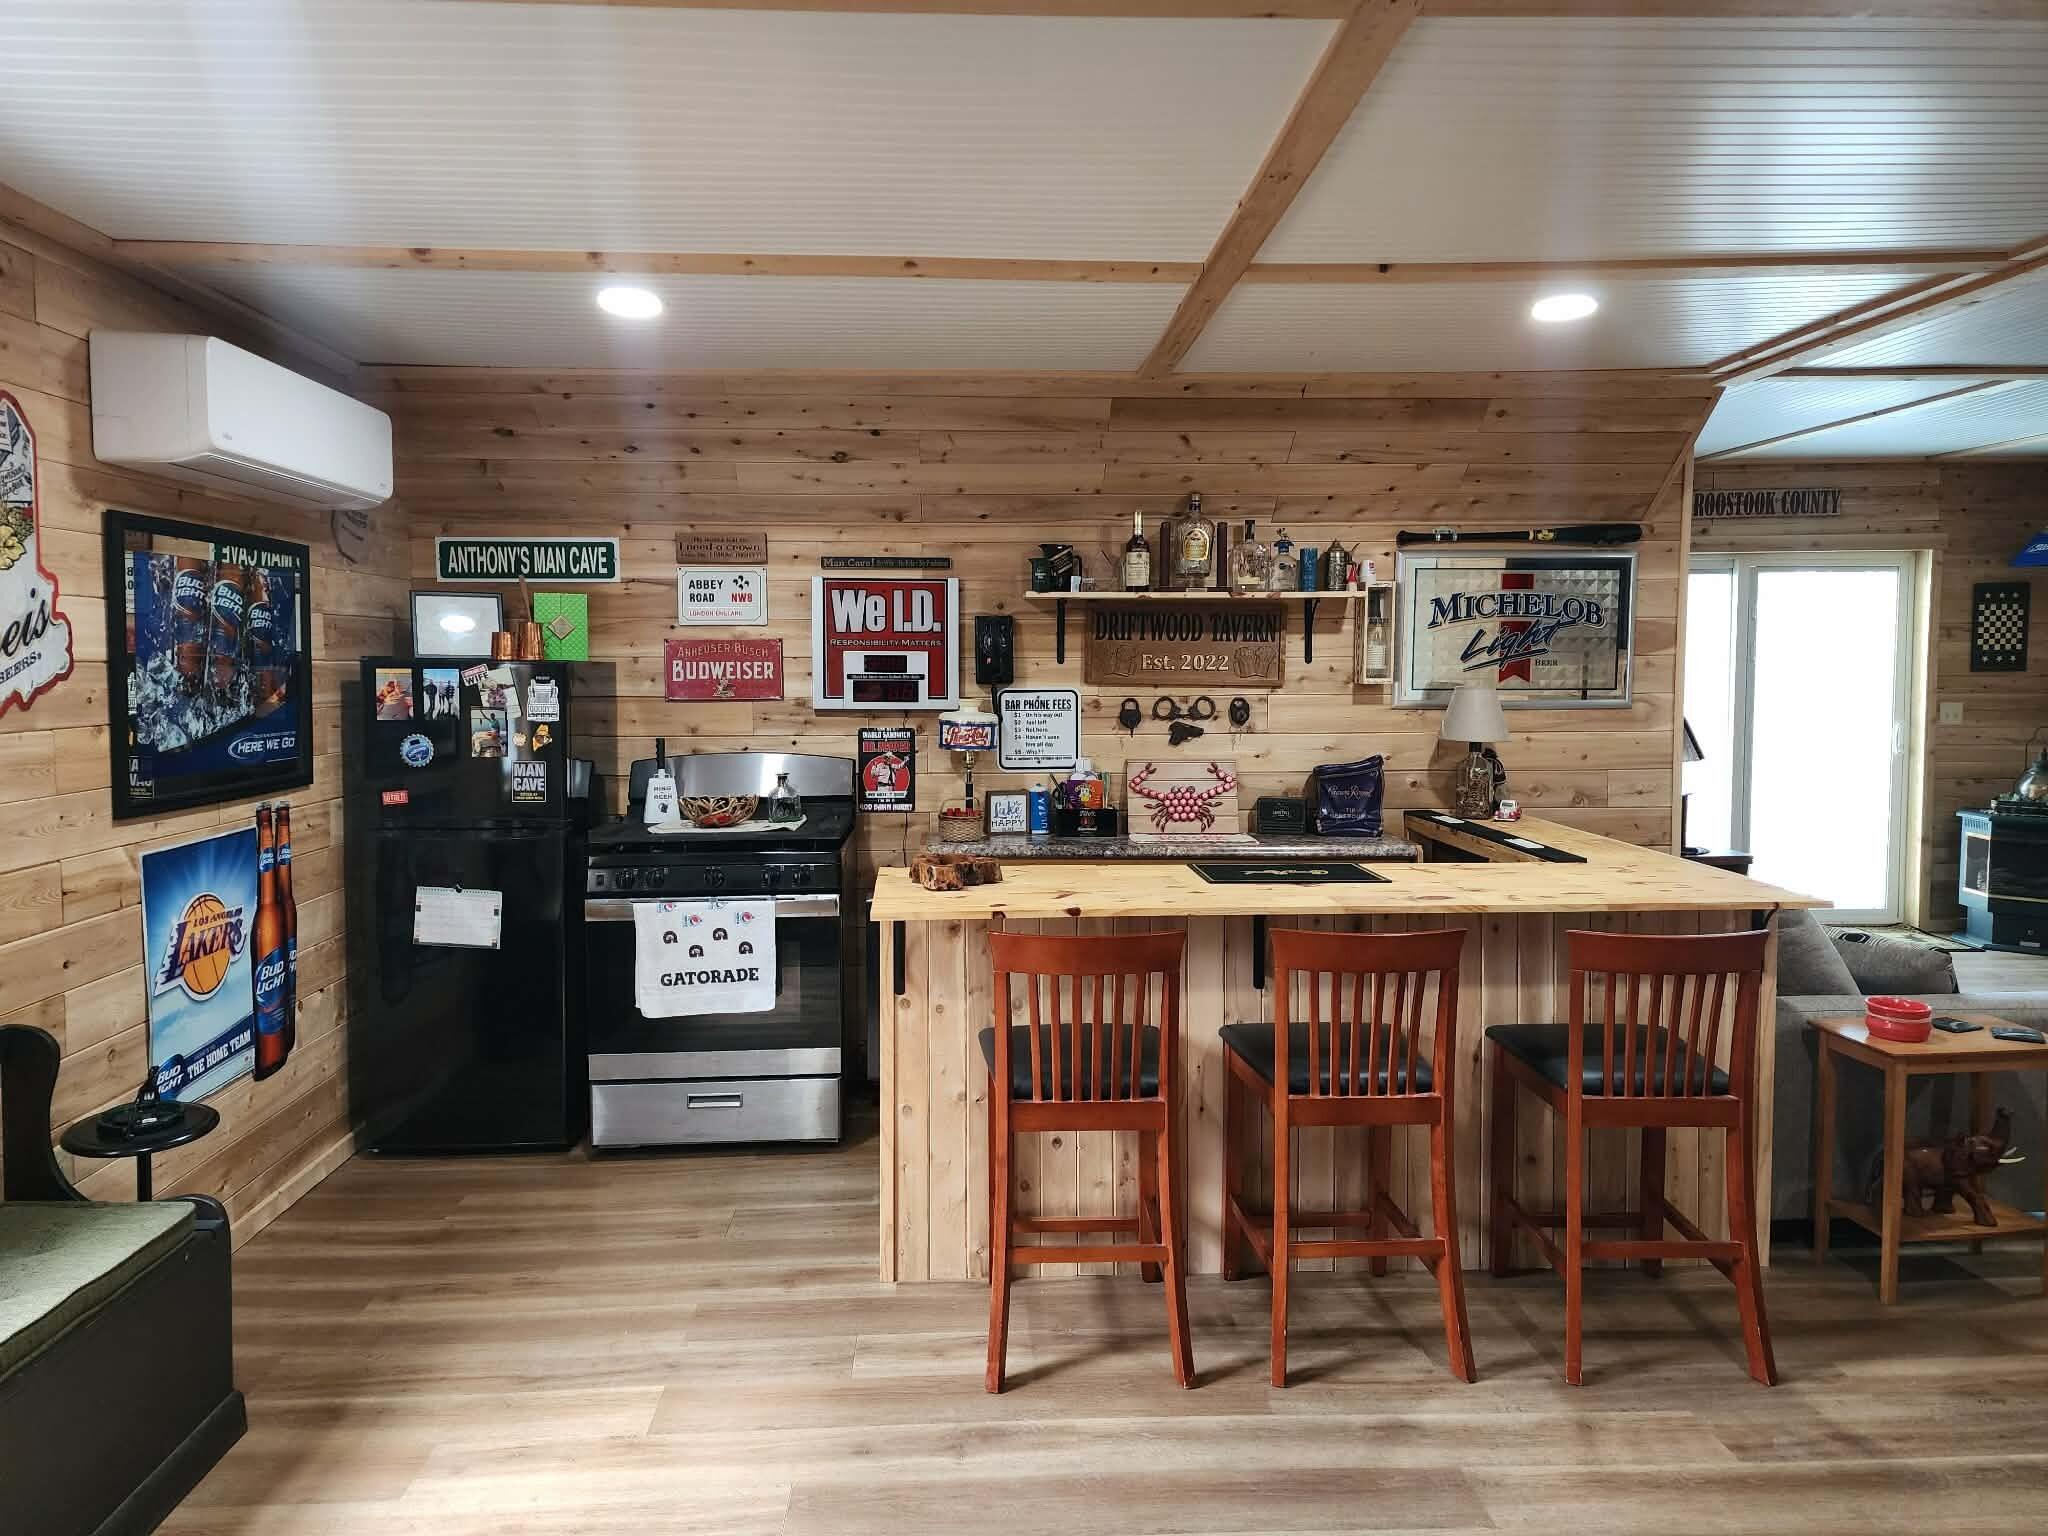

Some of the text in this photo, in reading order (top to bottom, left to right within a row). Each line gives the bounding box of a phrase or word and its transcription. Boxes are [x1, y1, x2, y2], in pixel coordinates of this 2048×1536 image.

[1694, 490, 1841, 516] ROOSTOOK COUNTY
[448, 546, 608, 574] ANTHONY'S MAN CAVE
[177, 575, 205, 590] BUD
[688, 579, 724, 590] ABBEY
[217, 584, 244, 605] BUD
[689, 593, 753, 602] ROAD NW8
[250, 608, 272, 621] BUD
[831, 589, 942, 633] We I.D.
[1427, 592, 1604, 628] MICHELOB
[1094, 612, 1278, 643] DRIFTWOOD TAVERN
[1459, 618, 1576, 670] Light
[672, 660, 774, 682] BUDWEISER
[1141, 654, 1229, 671] Est. 2022
[1535, 659, 1559, 667] BEER
[1005, 699, 1072, 710] BAR PHONE FEES
[237, 737, 296, 754] HERE WE GO
[513, 763, 545, 777] MAN
[513, 778, 545, 791] CAVE
[991, 819, 1025, 828] HAPPY
[193, 914, 209, 928] LOS
[160, 918, 247, 985] LAKERS
[261, 961, 284, 980] BUD
[660, 967, 760, 987] GATORADE
[256, 972, 286, 995] LIGHT
[187, 1058, 205, 1081] THE
[206, 1043, 229, 1069] HOME
[229, 1029, 251, 1053] TEAM
[156, 1064, 182, 1086] BUD
